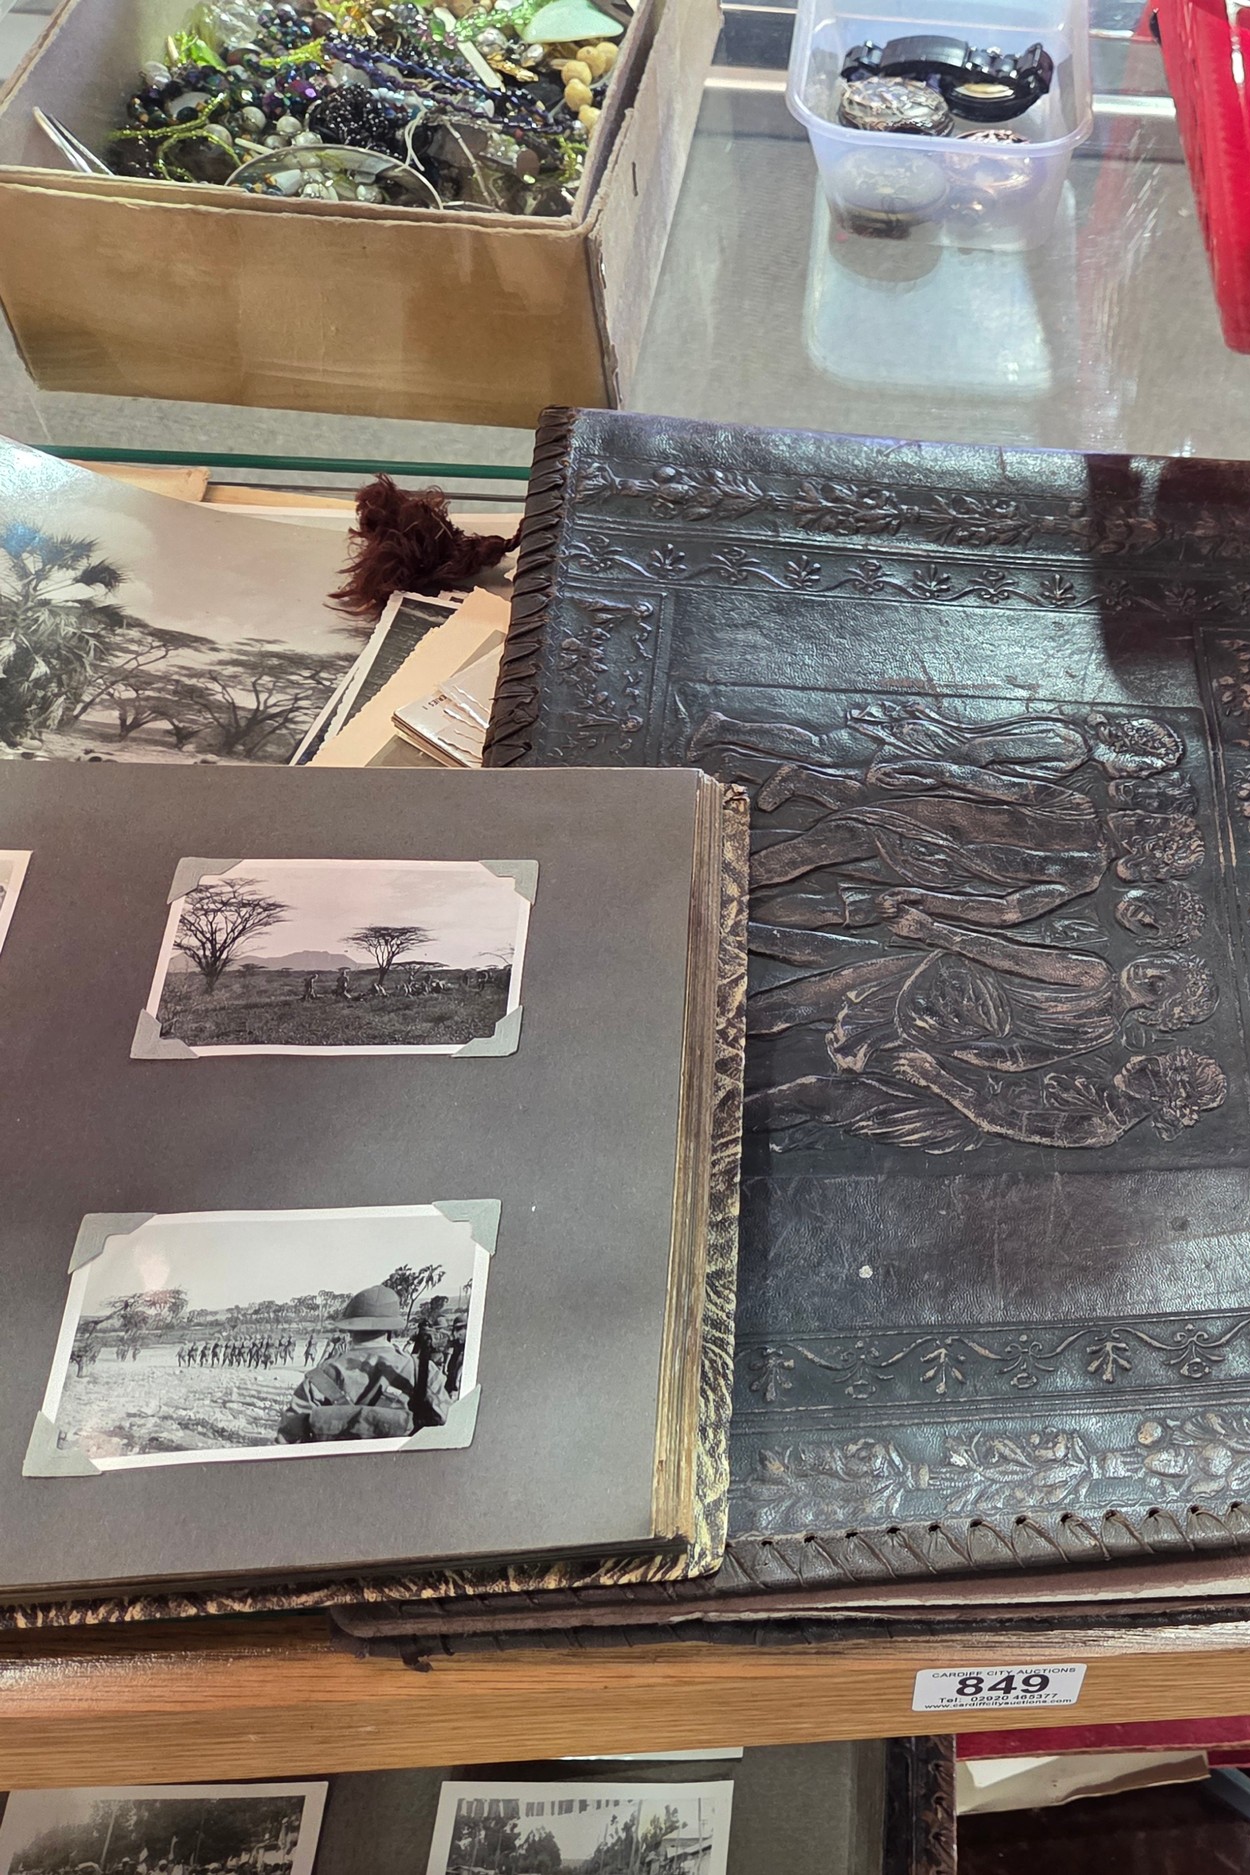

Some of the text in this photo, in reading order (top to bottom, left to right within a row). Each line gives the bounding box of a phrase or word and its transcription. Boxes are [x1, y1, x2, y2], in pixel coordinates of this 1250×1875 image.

[1017, 1667, 1076, 1675] AUCTIONS
[956, 1673, 1050, 1697] 849
[925, 1699, 1072, 1710] www.cardiffcityauctions.com
